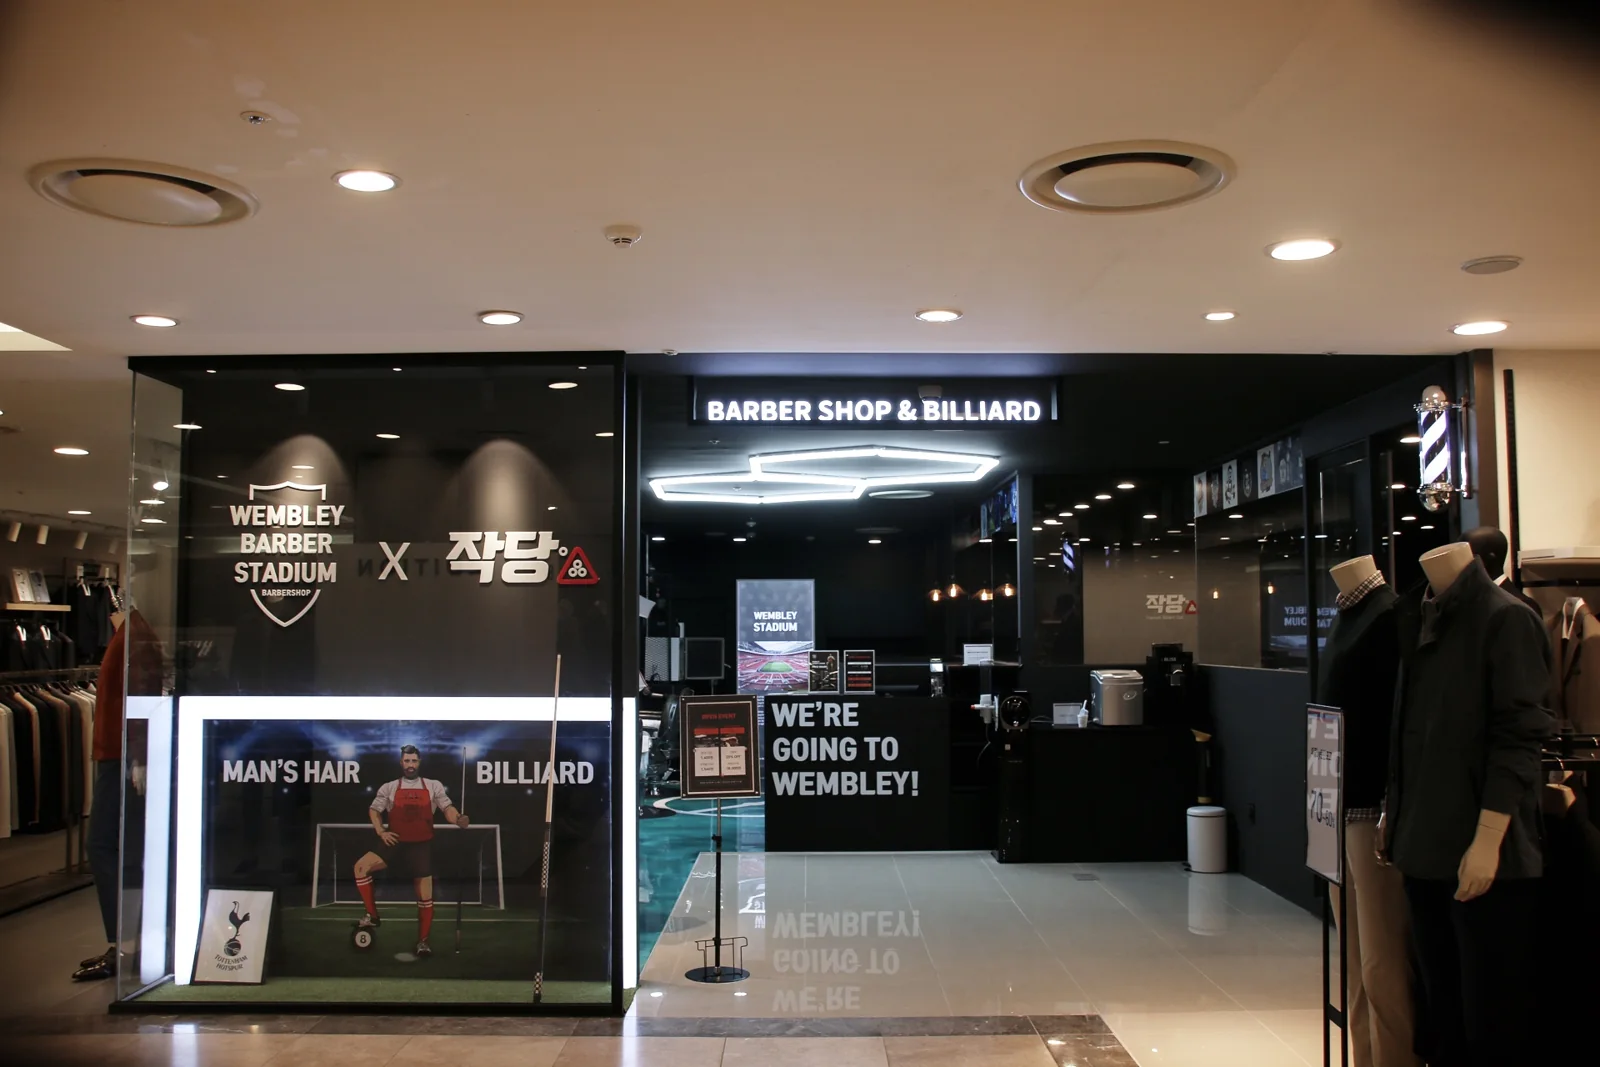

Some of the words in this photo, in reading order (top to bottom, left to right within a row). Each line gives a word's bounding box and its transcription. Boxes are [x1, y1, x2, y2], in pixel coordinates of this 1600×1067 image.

[707, 400, 812, 421] BARBER
[818, 399, 892, 421] SHOP
[898, 400, 918, 421] &
[922, 400, 1041, 421] BILLIARD
[229, 504, 345, 527] WEMBLEY
[240, 532, 333, 554] BARBER
[378, 541, 411, 581] X
[445, 531, 559, 583] 작당
[234, 561, 337, 583] STADIUM
[261, 588, 312, 597] BARBERSHOP
[753, 610, 798, 620] WEMBLEY
[1145, 594, 1187, 614] 작당
[753, 621, 798, 632] STADIUM
[772, 736, 858, 762] GOING
[863, 736, 899, 761] TO
[304, 760, 360, 784] HAIR
[476, 761, 594, 785] BILLIARD
[772, 770, 919, 797] WEMBLEY!
[360, 932, 367, 946] 8
[214, 954, 248, 965] TOTTENHAM
[215, 963, 244, 972] HOTSPUR
